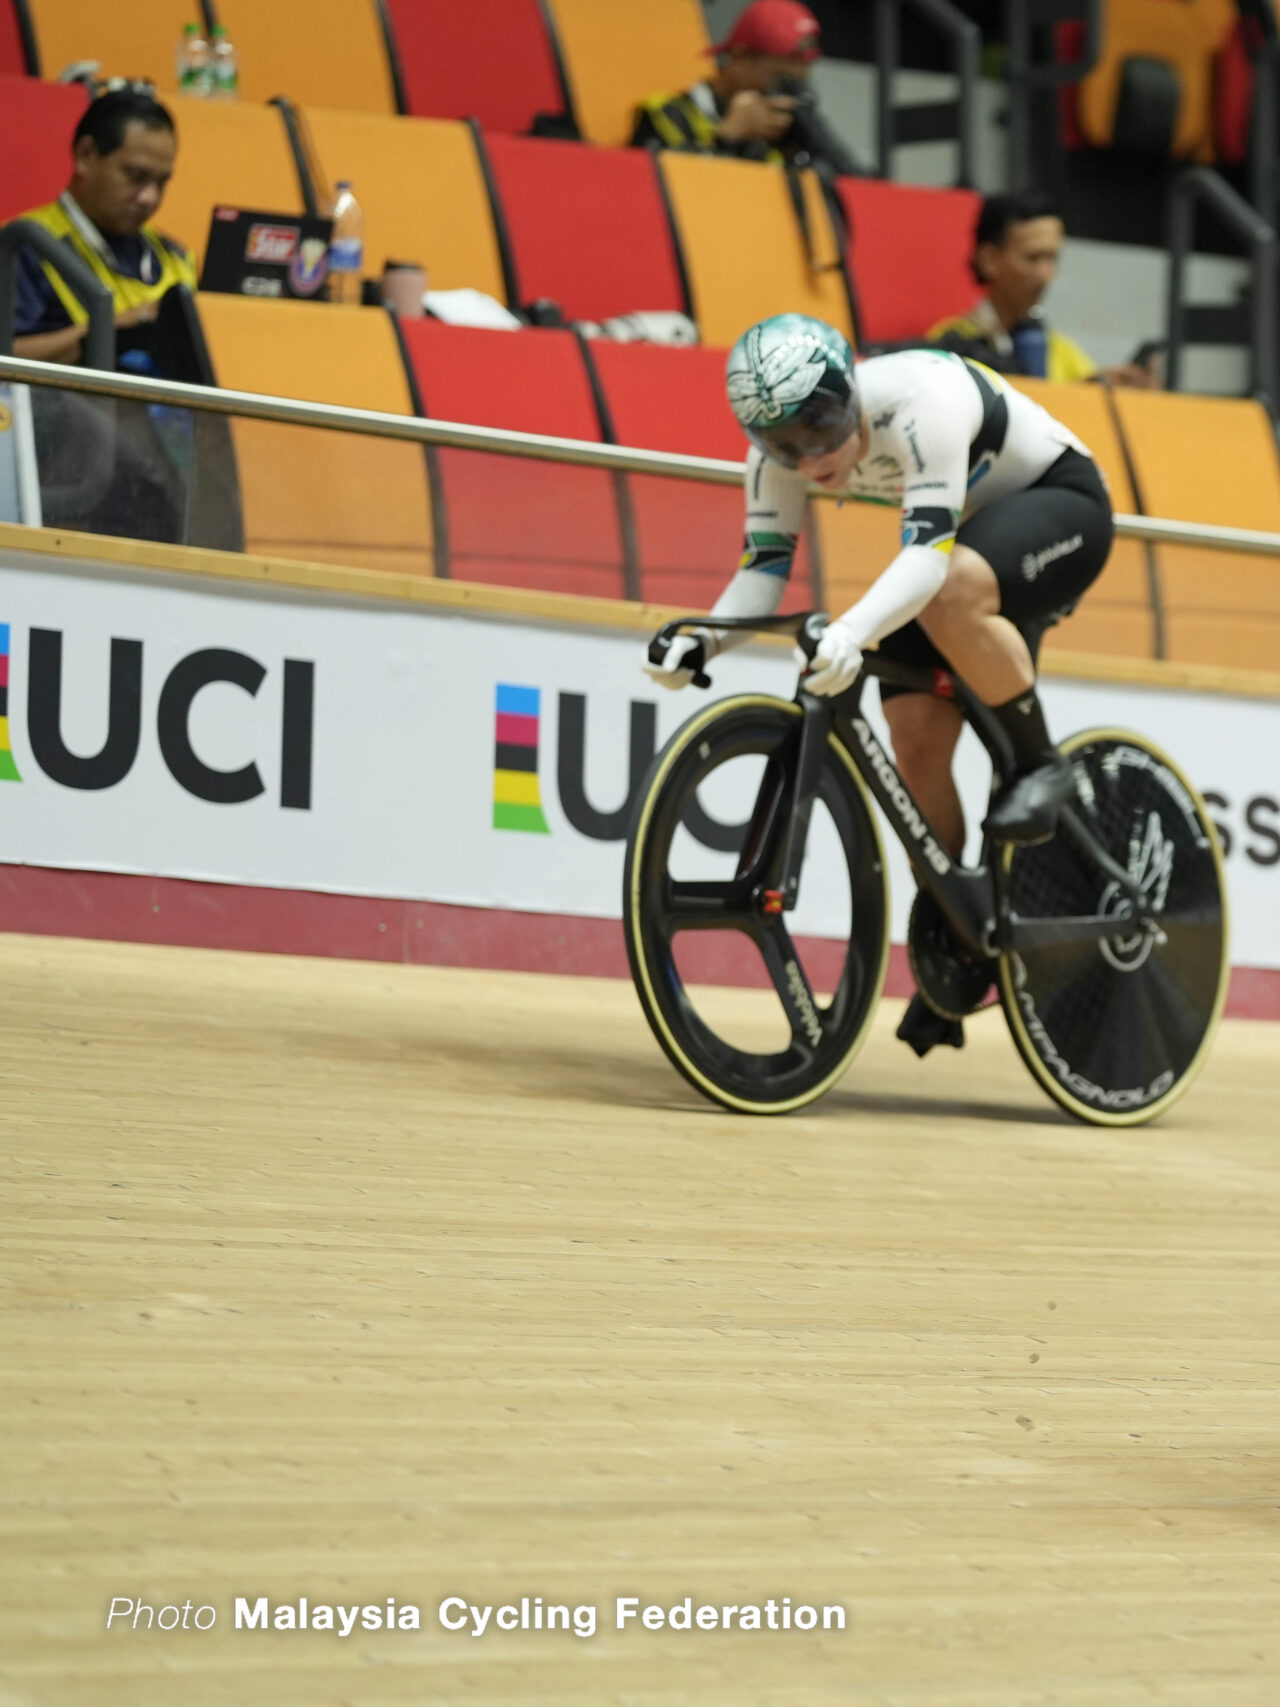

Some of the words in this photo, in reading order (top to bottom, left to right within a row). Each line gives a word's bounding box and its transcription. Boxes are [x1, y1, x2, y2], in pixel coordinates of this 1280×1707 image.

[27, 626, 315, 811] UCI
[852, 718, 928, 840] ARGON
[1011, 950, 1175, 1108] AMPAGNOLO
